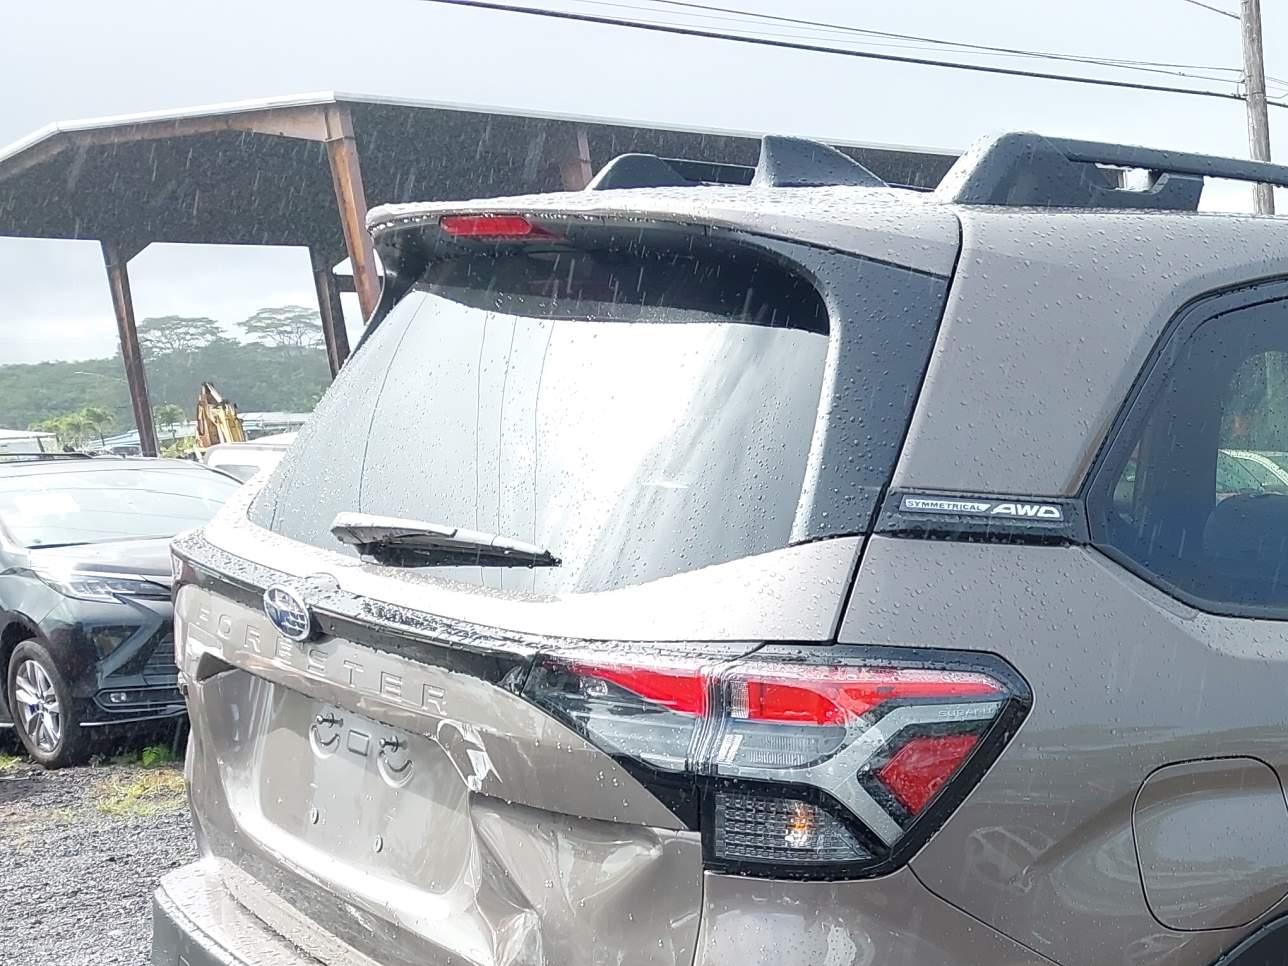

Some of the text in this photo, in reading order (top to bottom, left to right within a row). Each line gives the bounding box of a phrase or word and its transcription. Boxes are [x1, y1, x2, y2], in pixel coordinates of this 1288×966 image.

[907, 499, 1060, 518] SYMMETRICAL AWD
[199, 607, 448, 716] FORESTER
